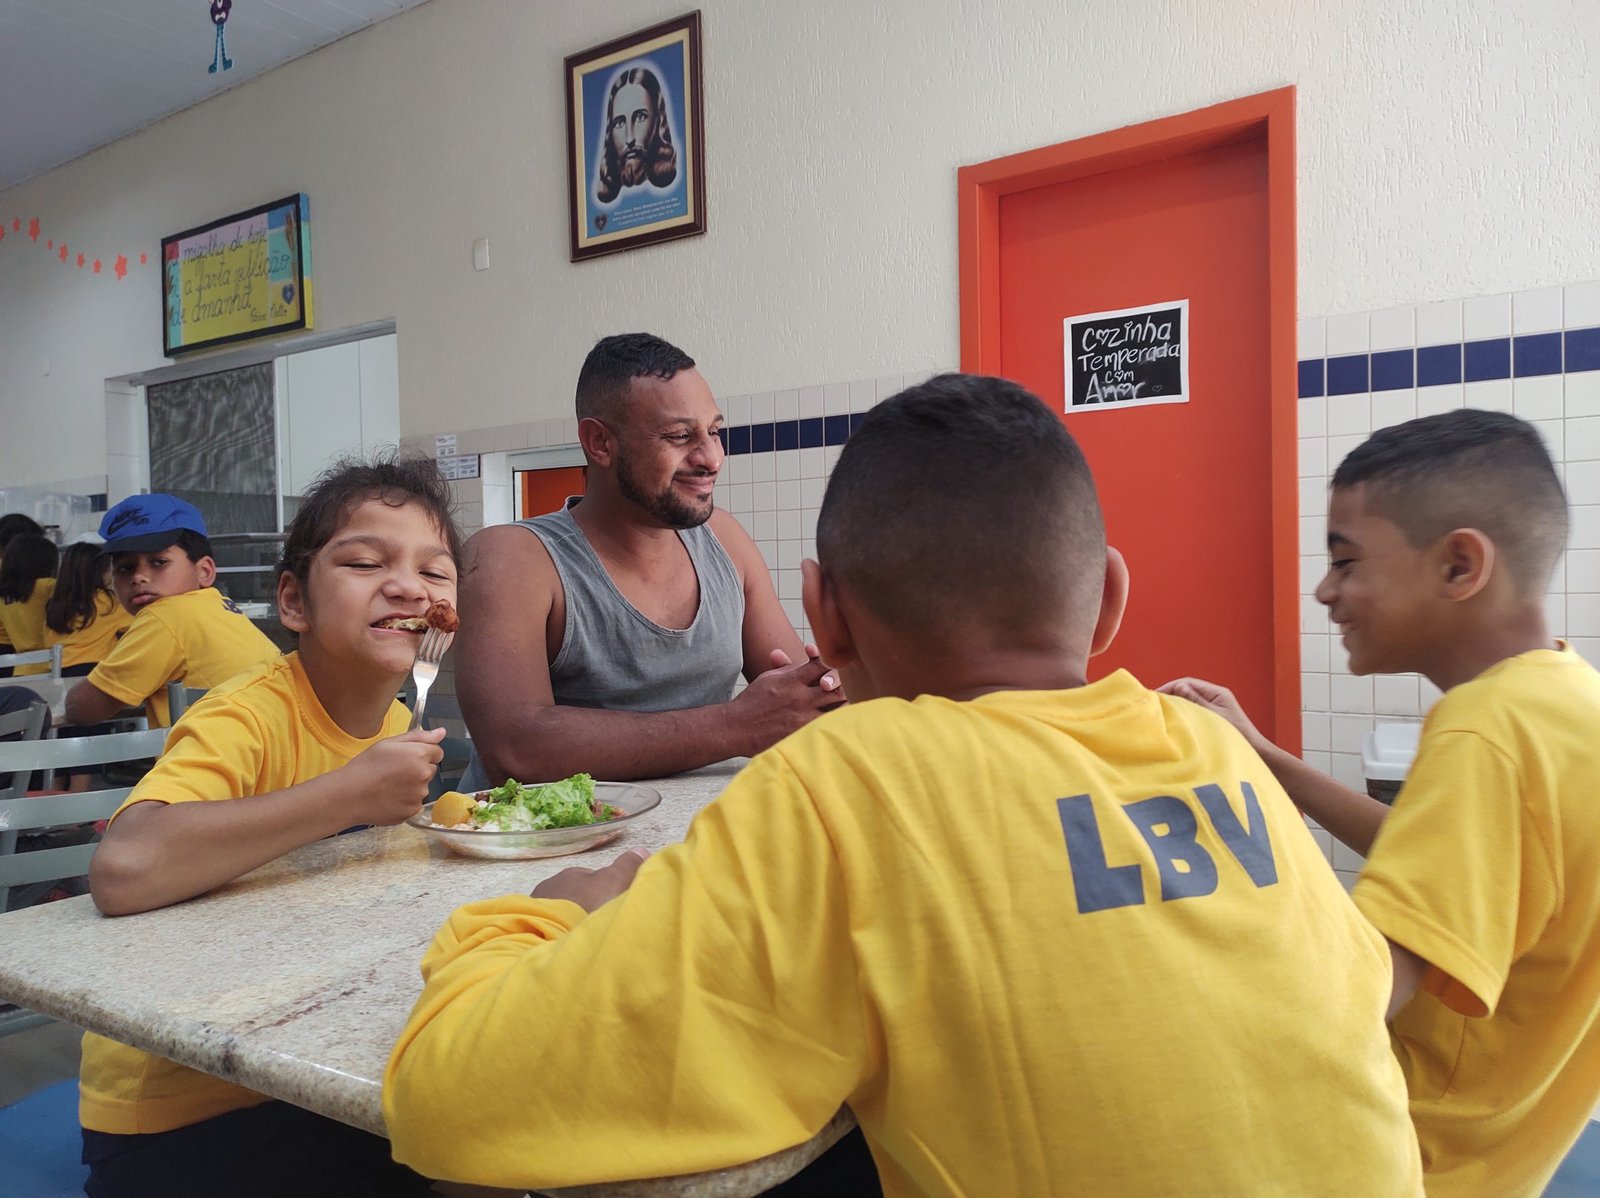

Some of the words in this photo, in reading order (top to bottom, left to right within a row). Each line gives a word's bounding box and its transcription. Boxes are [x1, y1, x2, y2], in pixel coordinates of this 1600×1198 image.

[1082, 315, 1172, 352] Cozinha
[1077, 341, 1181, 371] Temperada
[1085, 372, 1146, 404] Amor
[1056, 781, 1278, 914] LBV
